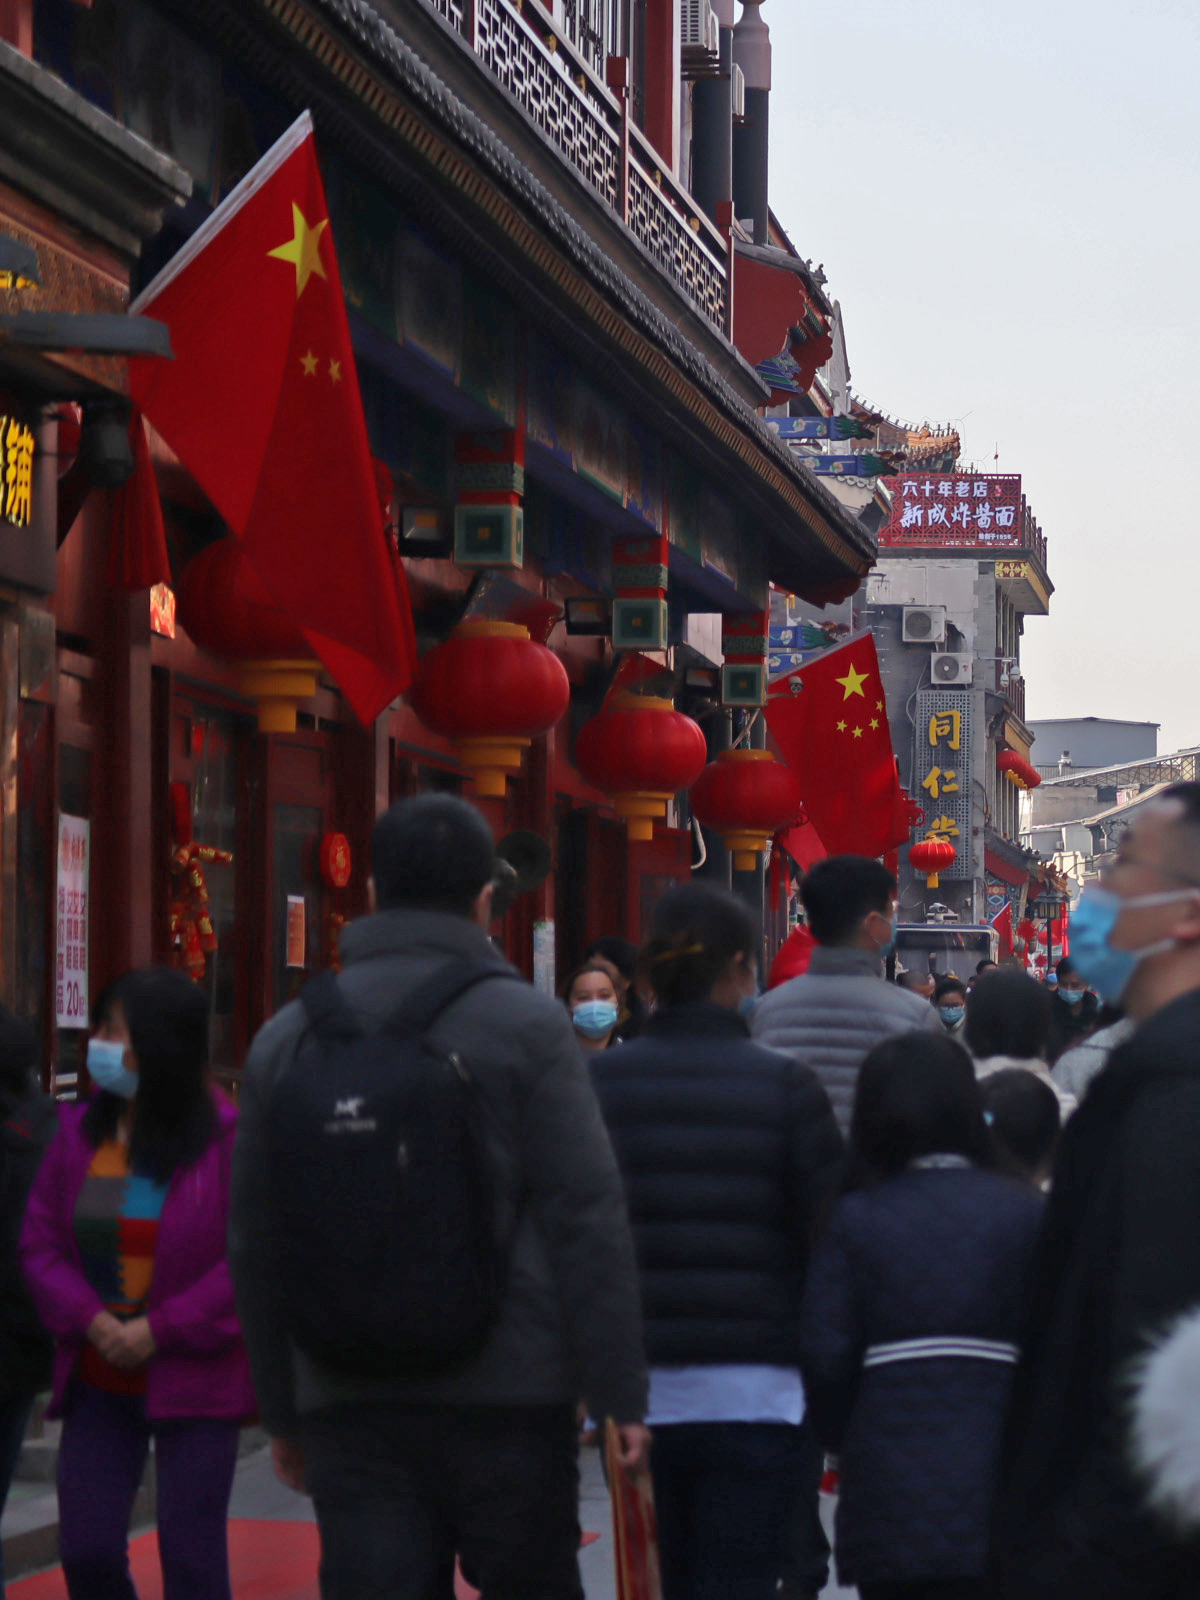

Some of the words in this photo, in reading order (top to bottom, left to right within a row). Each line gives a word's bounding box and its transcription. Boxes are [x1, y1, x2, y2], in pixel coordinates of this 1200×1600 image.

[902, 480, 988, 498] 六十年老店
